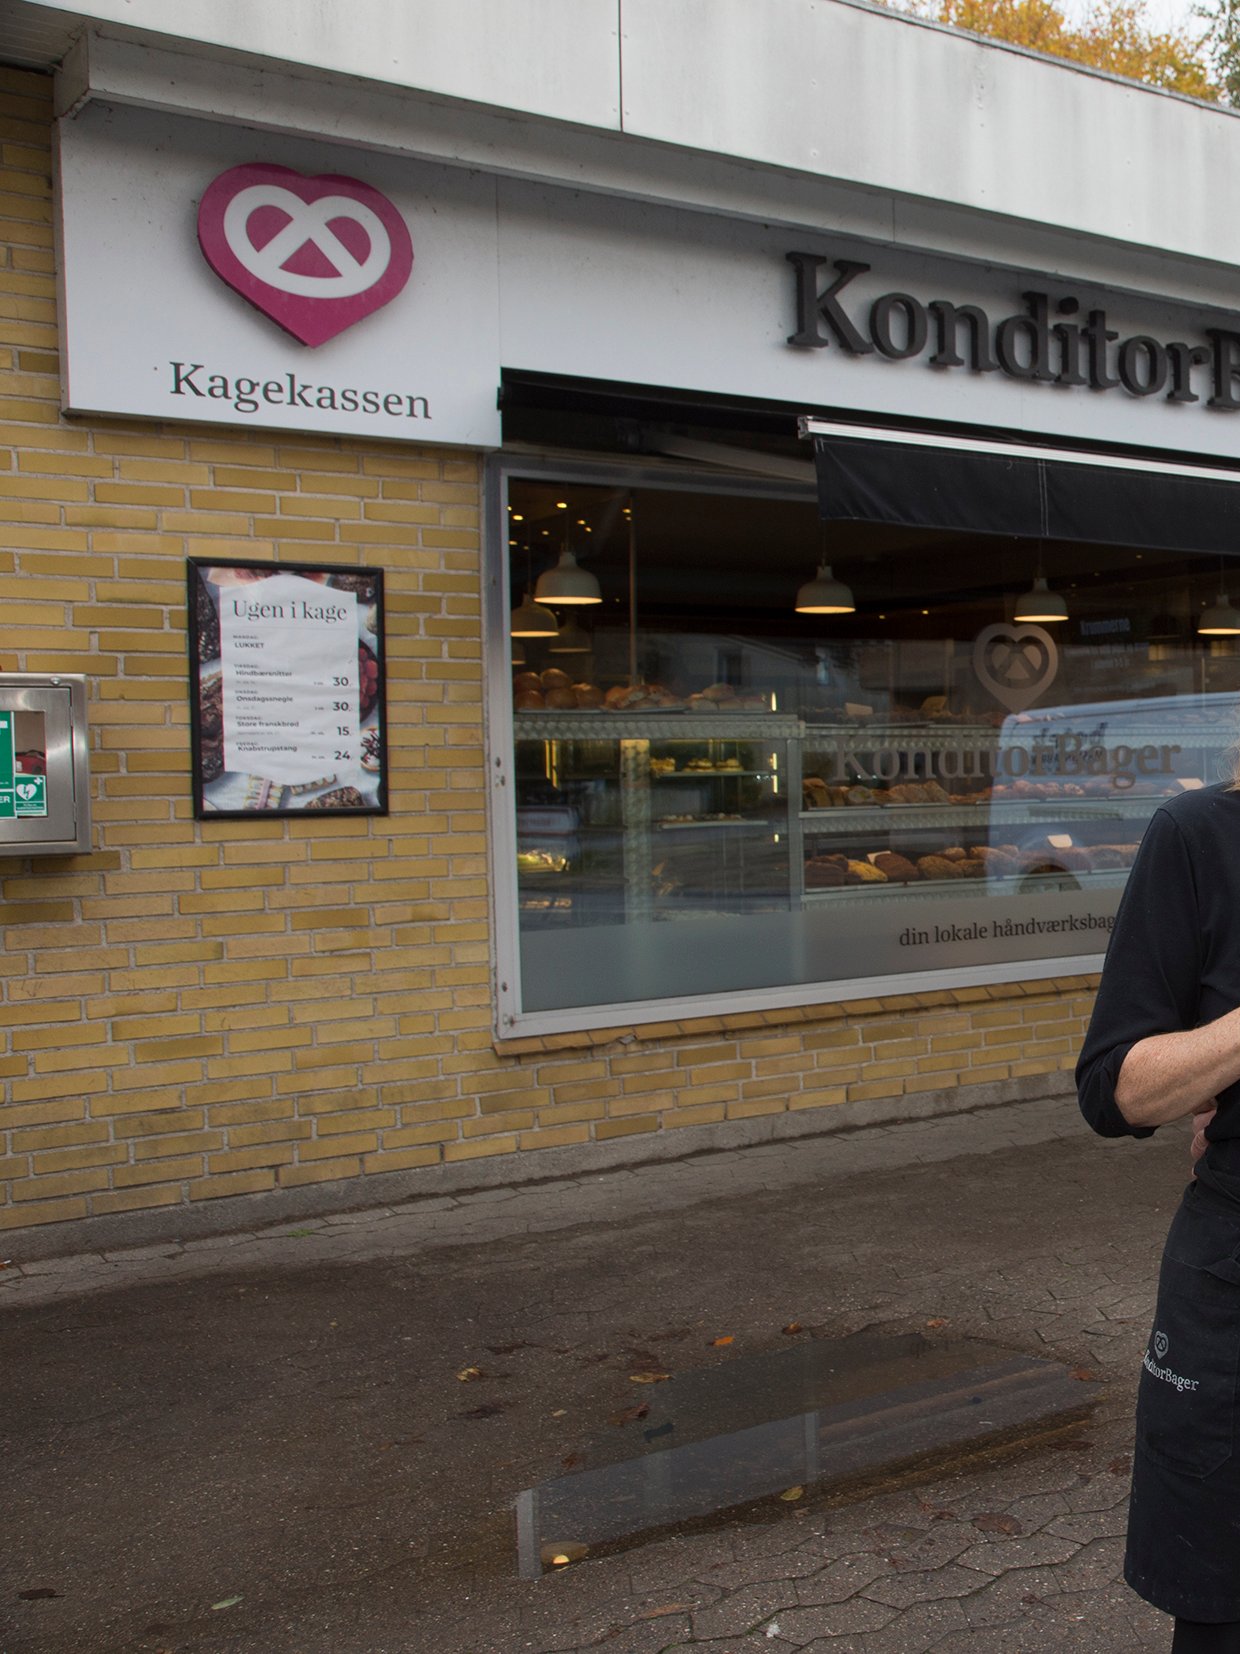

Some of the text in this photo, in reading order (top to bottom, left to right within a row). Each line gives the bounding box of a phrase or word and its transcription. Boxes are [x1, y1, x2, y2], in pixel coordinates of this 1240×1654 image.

[169, 361, 432, 420] Kagekassen
[232, 599, 348, 623] Ugen i kage
[236, 694, 294, 703] Onsdagssnegle
[236, 720, 258, 728] Store
[832, 731, 1181, 790] KonditorBager
[899, 913, 1118, 947] din lokale håndværksbag
